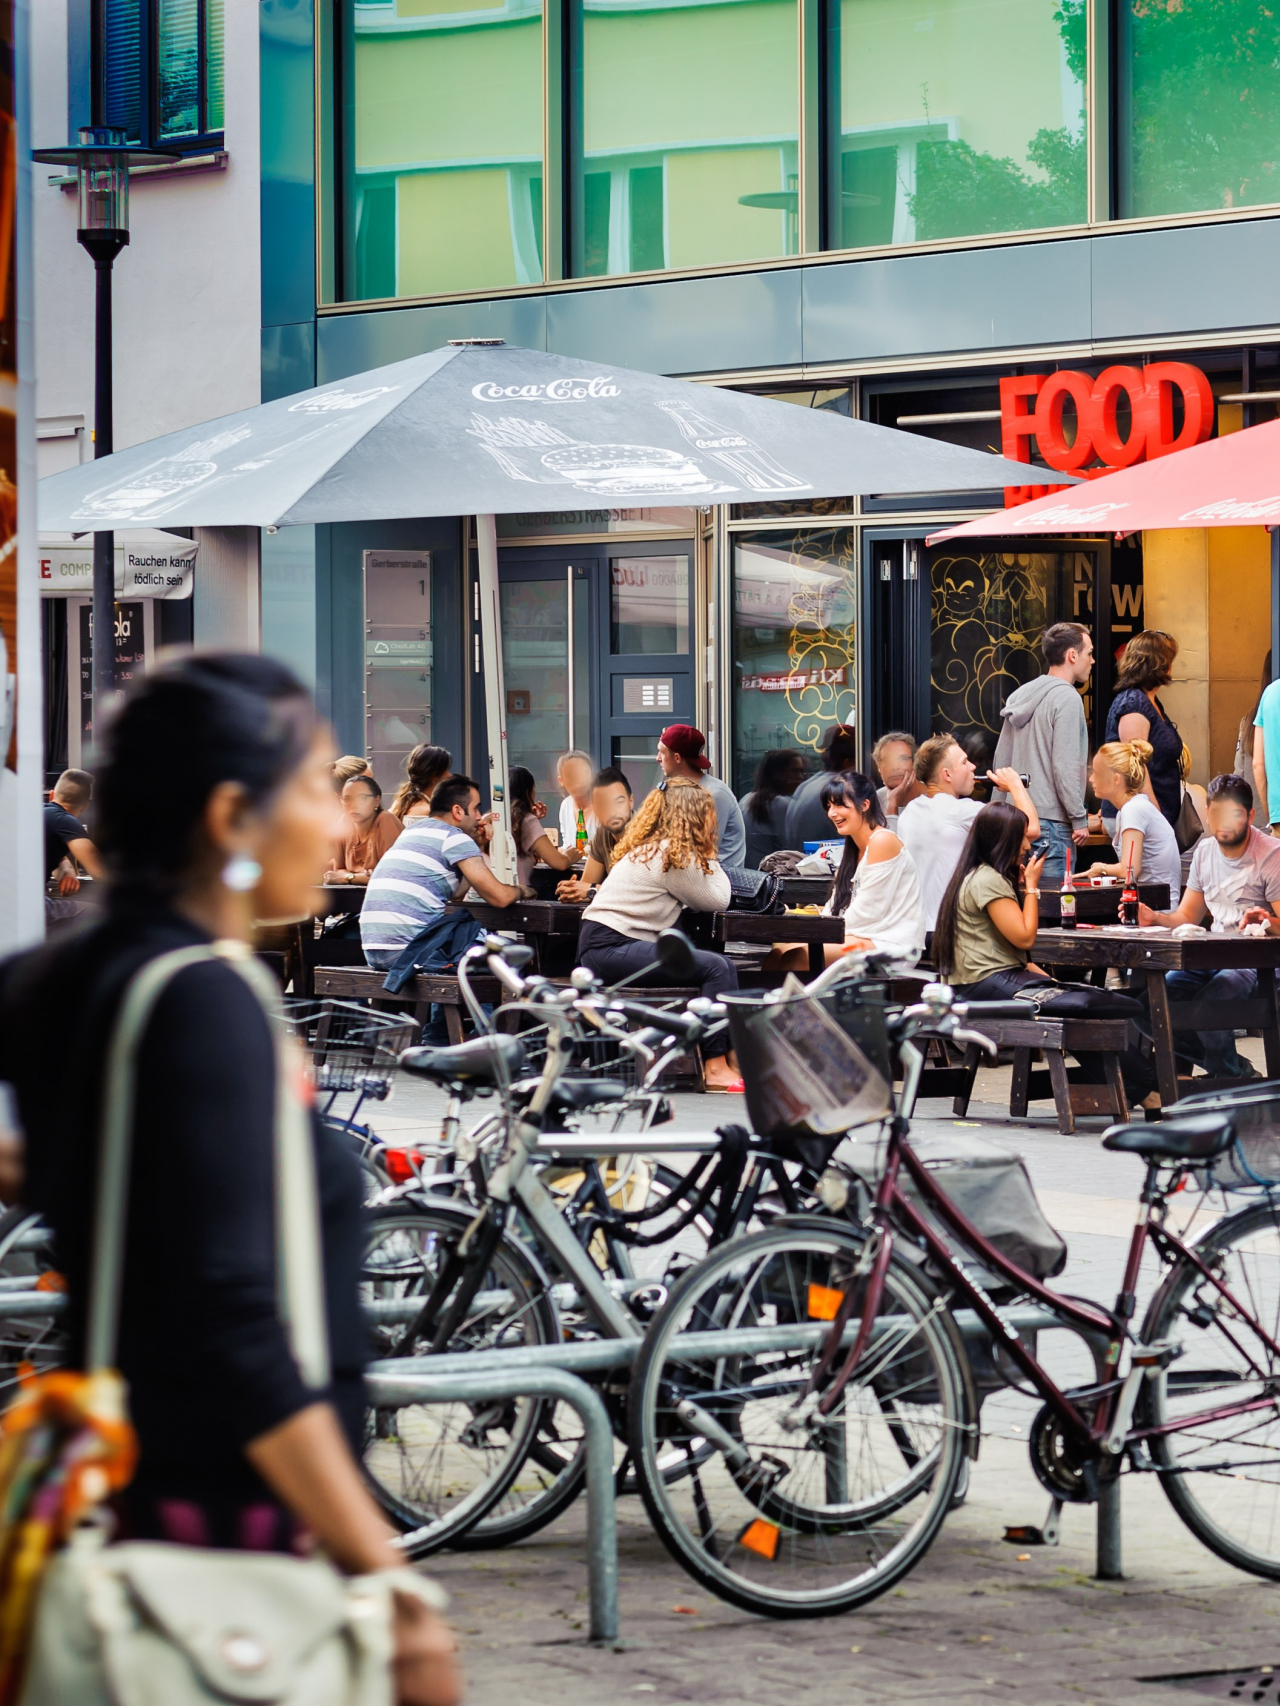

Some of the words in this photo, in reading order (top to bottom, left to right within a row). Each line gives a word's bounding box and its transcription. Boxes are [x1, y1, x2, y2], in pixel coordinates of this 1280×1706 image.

[471, 375, 621, 402] Coca-Cola
[999, 361, 1214, 472] FOOD
[129, 554, 167, 568] Rauchen
[169, 556, 191, 568] kann
[371, 559, 427, 569] Gerberstraße
[60, 562, 94, 576] COMP
[134, 572, 164, 586] tödlich
[166, 574, 183, 586] sein
[418, 579, 425, 596] 1
